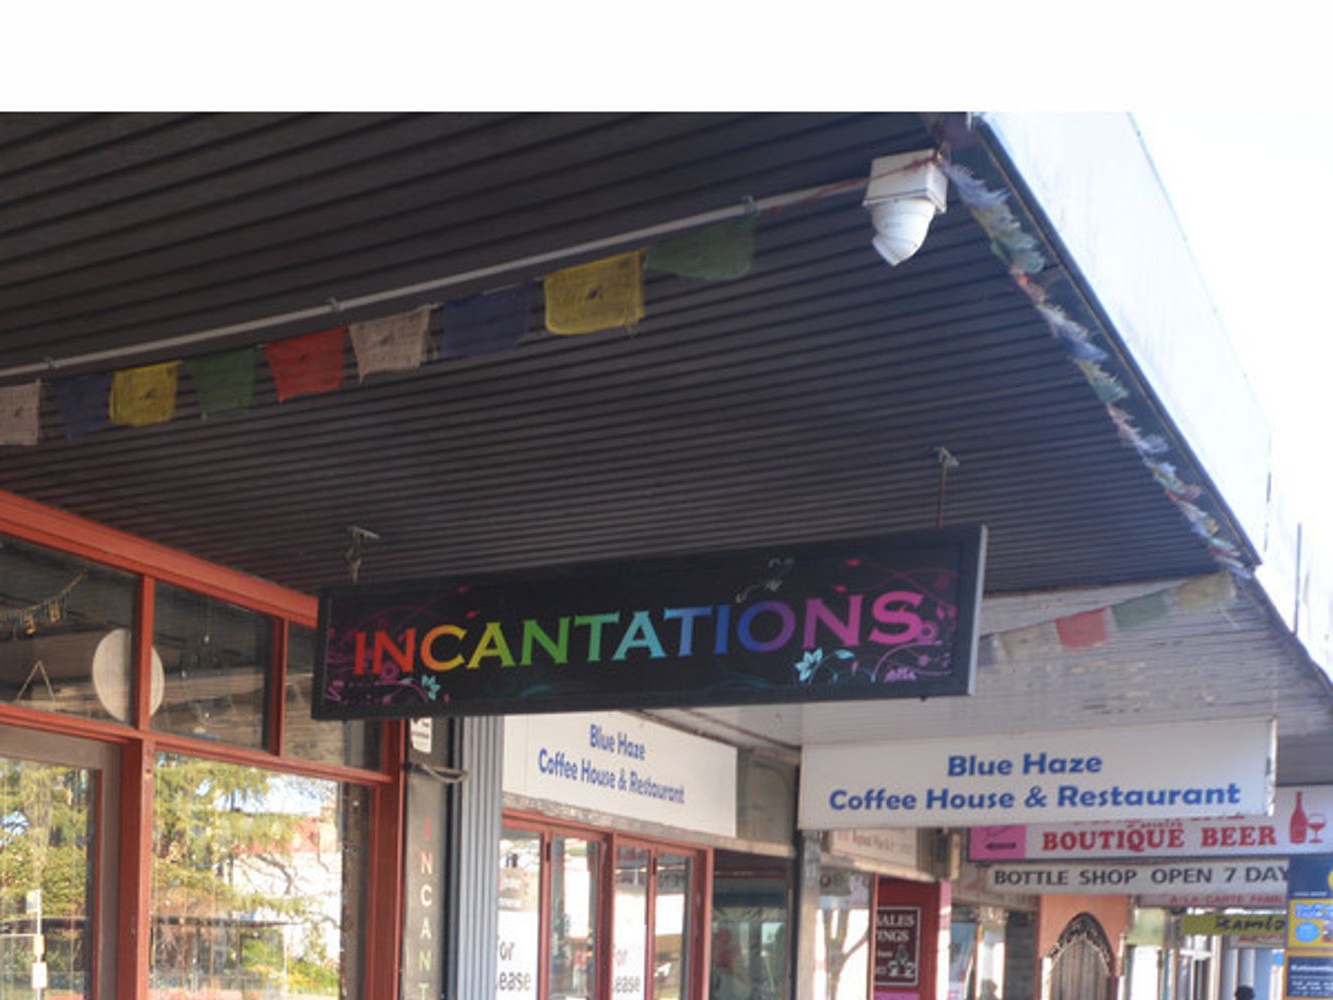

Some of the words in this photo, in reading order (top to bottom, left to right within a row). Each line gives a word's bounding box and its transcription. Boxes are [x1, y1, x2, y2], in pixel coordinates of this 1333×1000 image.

[353, 590, 925, 676] INCANTATIONS
[589, 723, 615, 753] Blue
[617, 731, 646, 761] Haze
[538, 747, 578, 781] Coffee
[581, 757, 615, 789] House
[617, 768, 627, 792] &
[629, 770, 685, 804] Restaurant
[947, 754, 1014, 777] Blue
[1022, 751, 1103, 776] Haze
[828, 787, 917, 811] Coffee
[925, 786, 1015, 810] House
[1024, 785, 1048, 809] &
[1056, 782, 1241, 808] Restaurant
[1042, 828, 1186, 852] BOUTIQUE
[1201, 824, 1277, 848] BEER
[994, 868, 1069, 887] BOTTLE
[1079, 867, 1137, 886] SHOP
[1150, 867, 1213, 885] OPEN
[1225, 867, 1237, 884] 7
[498, 937, 516, 961] or
[496, 970, 532, 991] ease
[612, 975, 641, 994] ease
